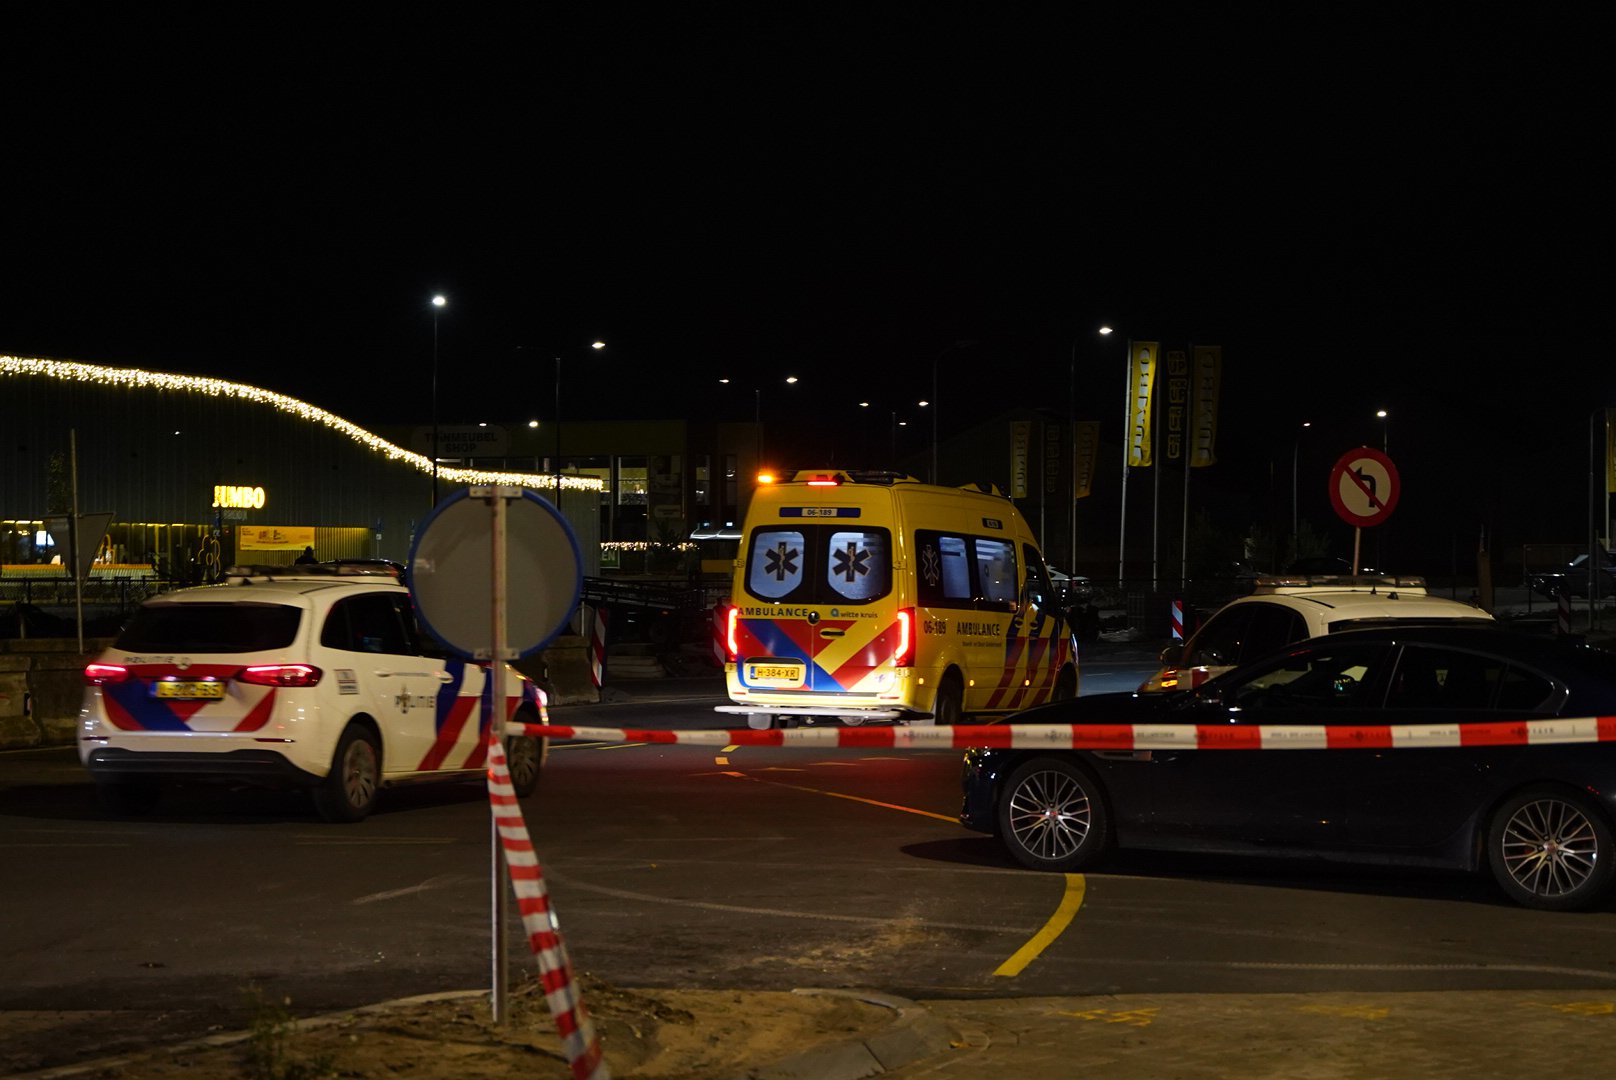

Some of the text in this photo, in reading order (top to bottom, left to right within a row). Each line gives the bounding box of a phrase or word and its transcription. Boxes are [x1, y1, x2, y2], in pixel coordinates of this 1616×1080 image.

[1134, 347, 1150, 460] JUMBO
[1199, 351, 1215, 460] JUMBO
[446, 443, 476, 452] SHOP
[212, 485, 265, 509] JUMBO
[738, 607, 808, 617] AMBULANCE
[841, 610, 878, 619] witte kruis
[923, 620, 947, 635] 06-189
[956, 621, 1000, 636] AMBULANCE
[757, 668, 796, 677] H-384-XR
[395, 695, 435, 708] PLITIE
